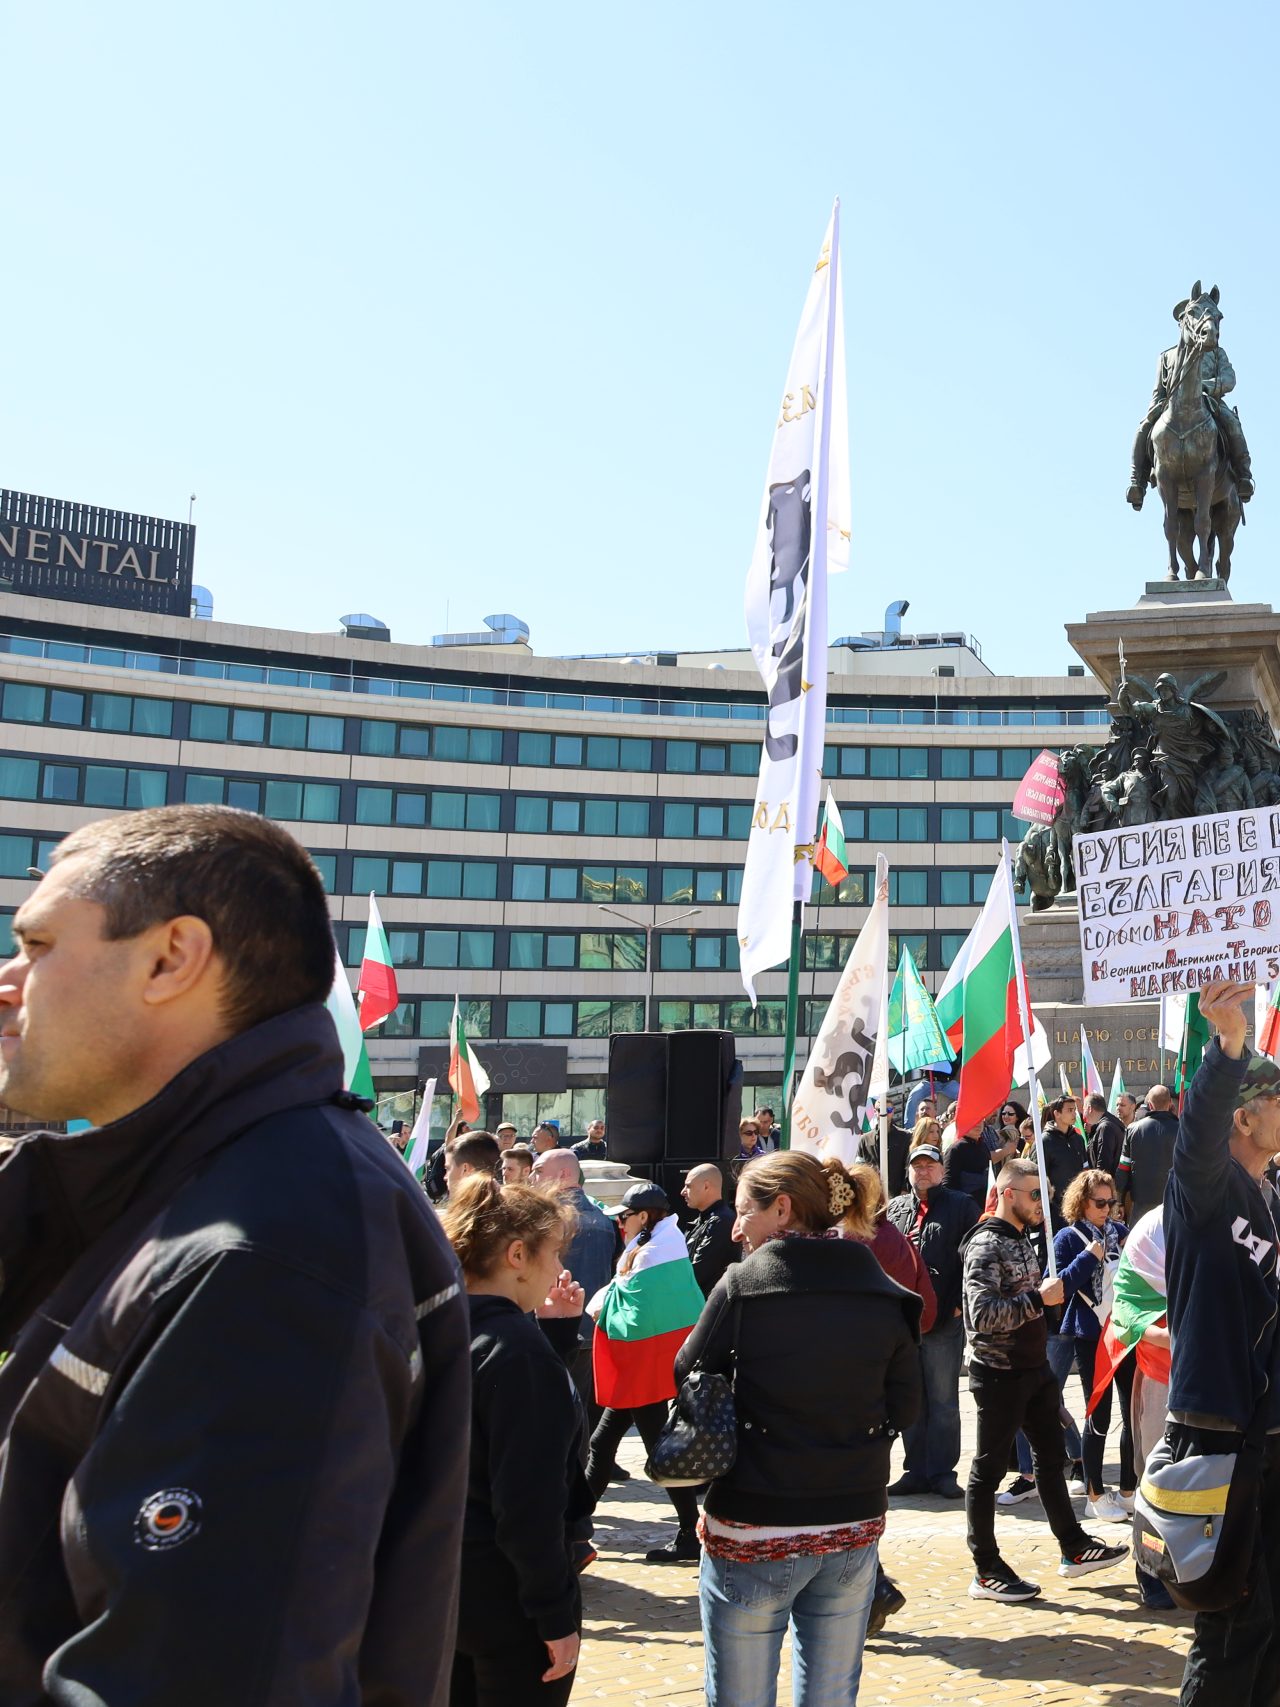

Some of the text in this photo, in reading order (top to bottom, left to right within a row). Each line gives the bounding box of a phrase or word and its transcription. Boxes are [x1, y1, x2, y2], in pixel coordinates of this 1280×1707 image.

[1078, 826, 1186, 877] РУСИЯ
[1192, 819, 1230, 857] НЕ
[1238, 816, 1257, 852] Е
